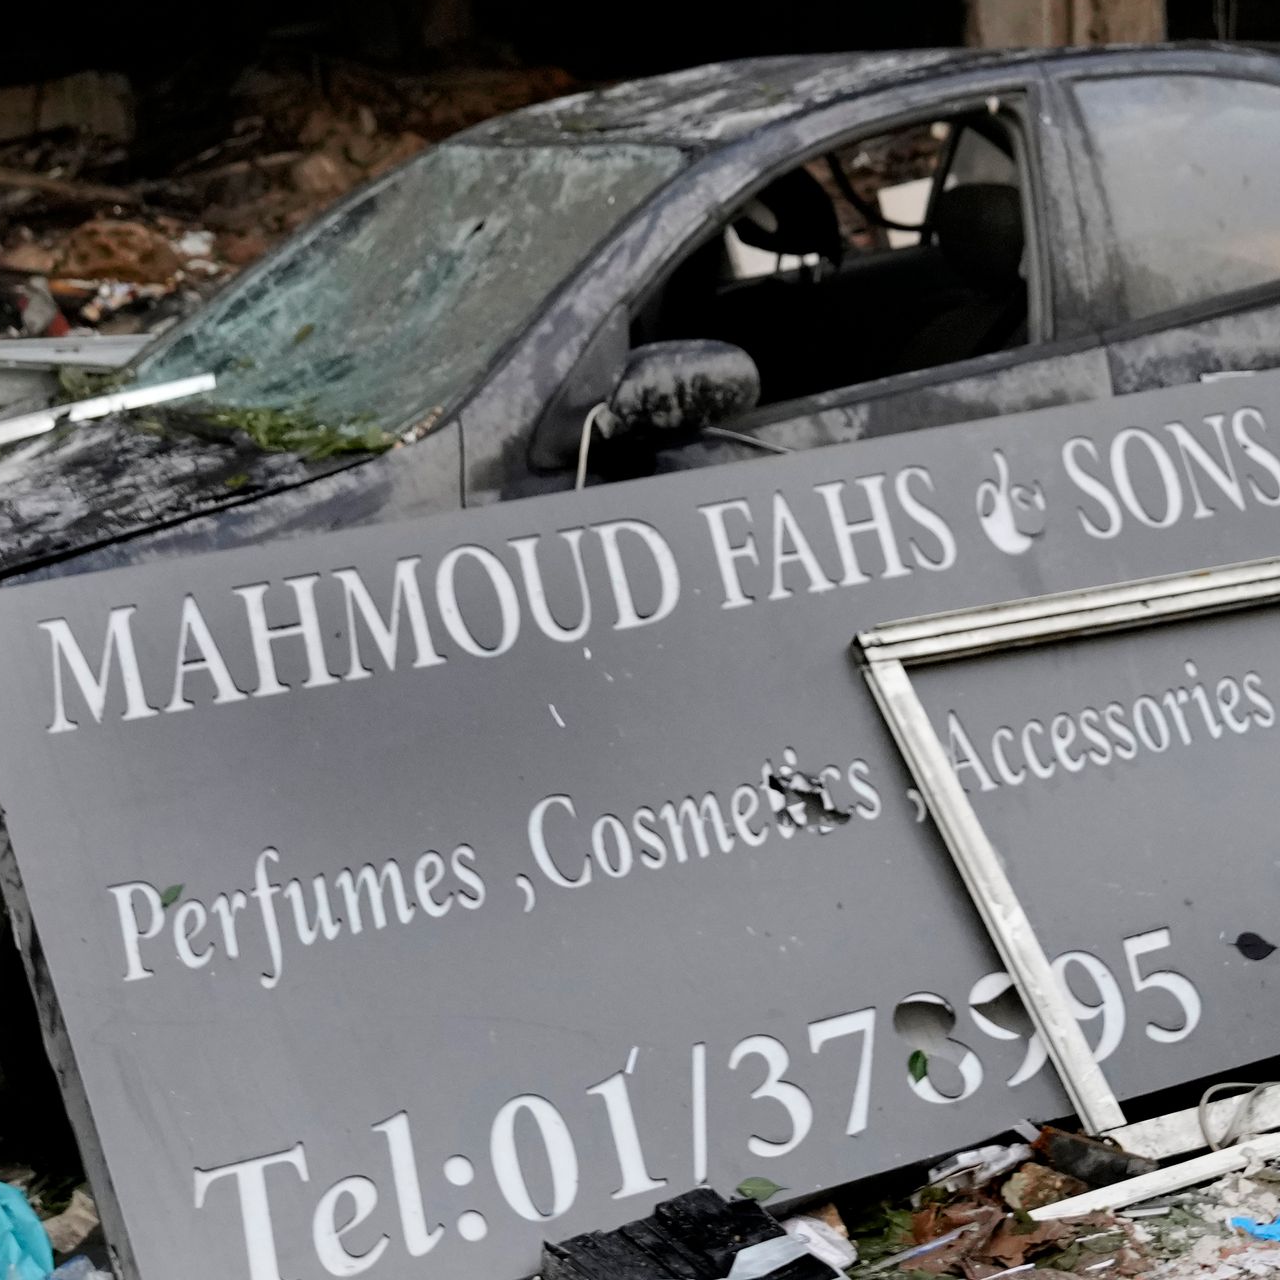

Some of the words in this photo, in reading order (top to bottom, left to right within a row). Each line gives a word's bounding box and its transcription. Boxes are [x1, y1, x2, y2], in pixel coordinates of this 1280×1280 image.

[38, 517, 681, 734] MAHMOUD
[698, 466, 958, 610] FAHS
[107, 845, 487, 988] Perfumes
[947, 660, 1276, 792] Accessories
